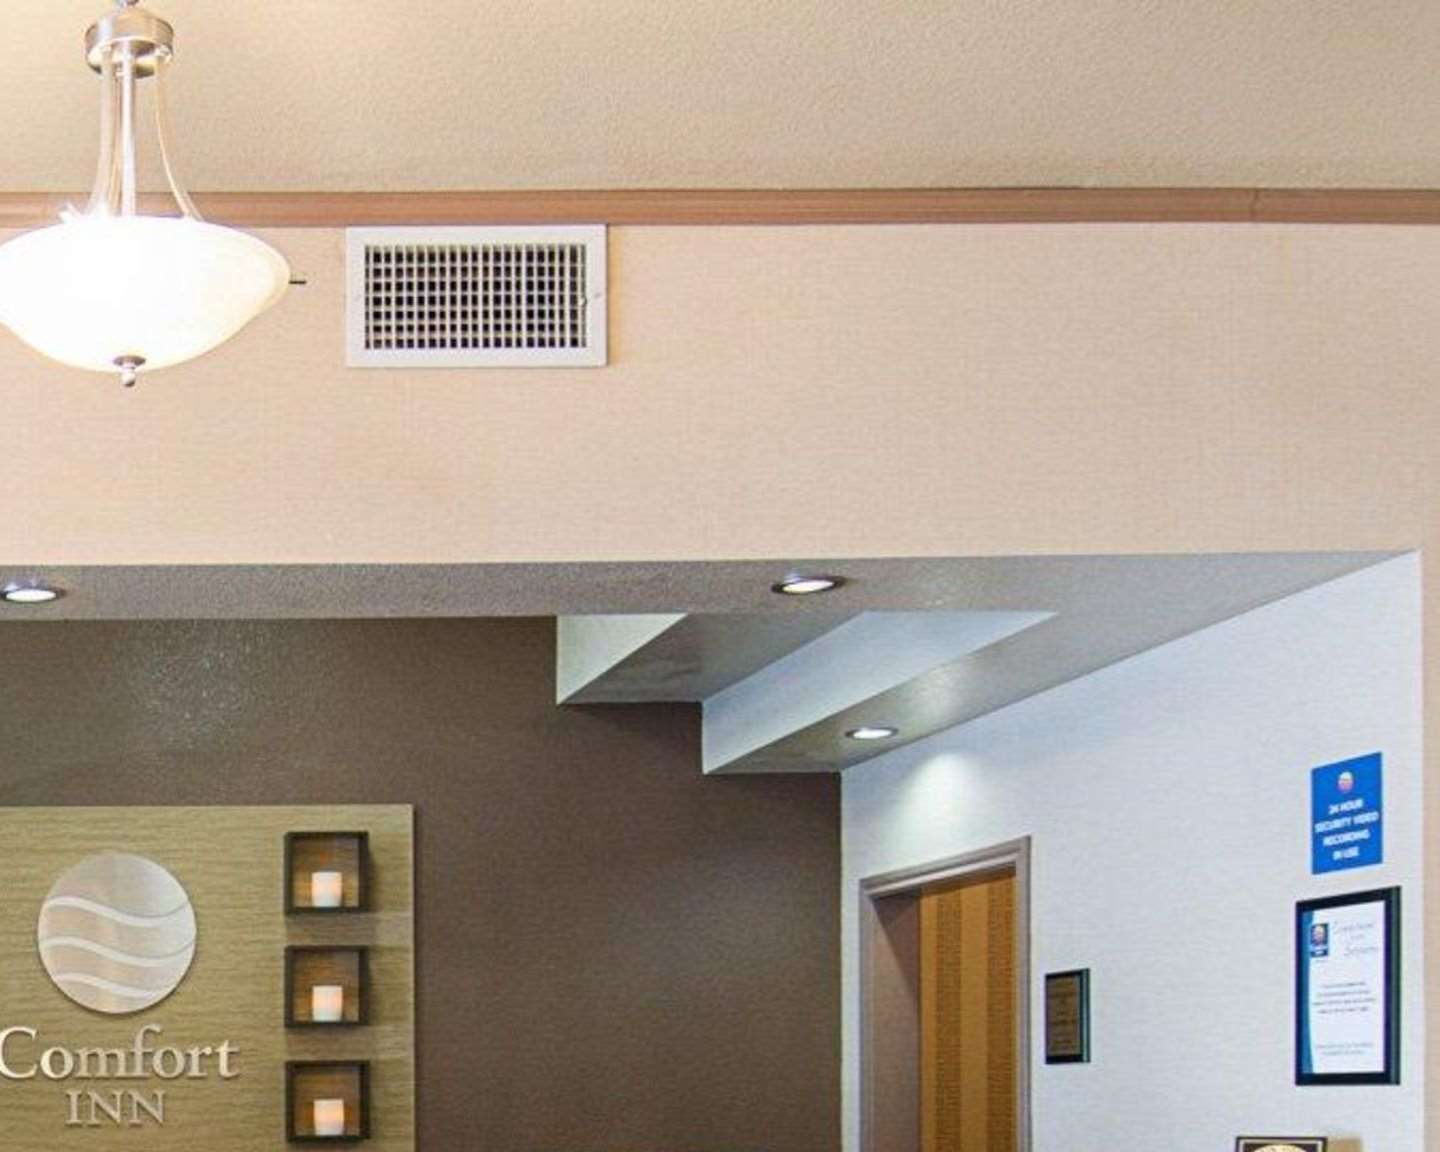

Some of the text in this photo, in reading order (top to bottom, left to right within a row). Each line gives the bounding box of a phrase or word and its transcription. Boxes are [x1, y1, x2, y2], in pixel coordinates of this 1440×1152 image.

[1340, 798, 1364, 812] HOUR
[1314, 811, 1380, 833] SECURITY VIDEO
[1323, 829, 1371, 847] RECORDING
[65, 1089, 166, 1127] INN
